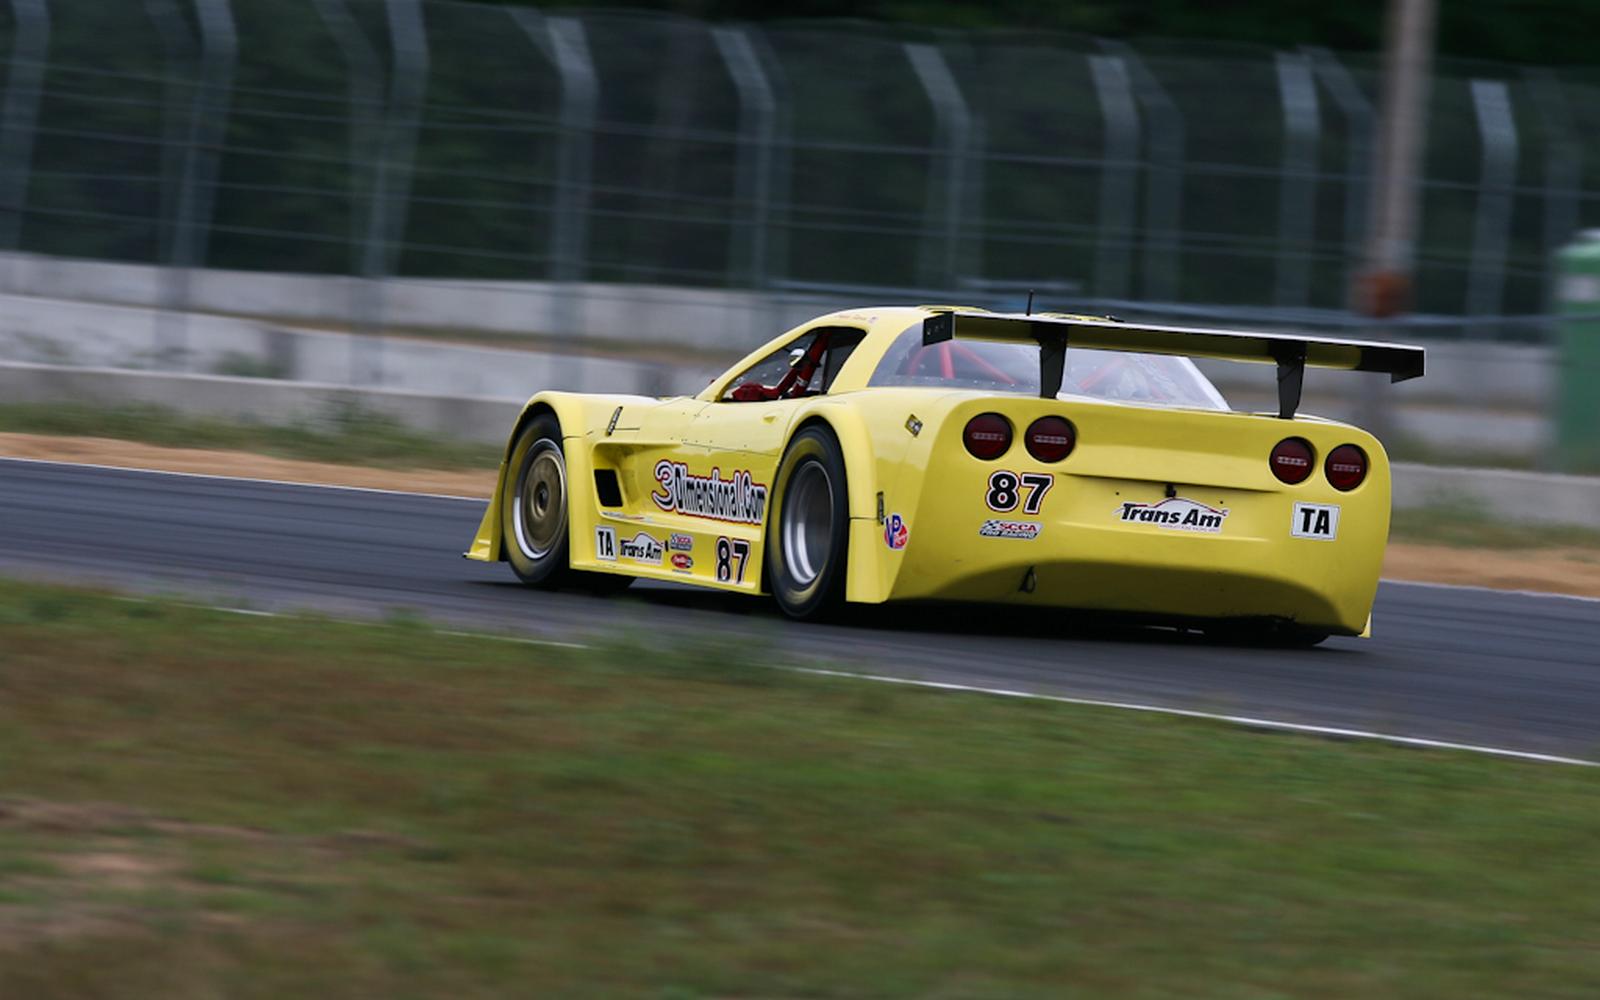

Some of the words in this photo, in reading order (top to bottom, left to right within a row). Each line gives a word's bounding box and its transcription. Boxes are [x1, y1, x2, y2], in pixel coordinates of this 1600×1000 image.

[985, 469, 1054, 515] 87
[999, 522, 1037, 532] SCCA
[1121, 503, 1181, 523] Trans
[1182, 508, 1222, 527] Am
[1300, 507, 1331, 535] TA
[598, 530, 614, 556] TA
[620, 539, 645, 558] Trans
[645, 541, 662, 560] Am
[716, 536, 751, 584] 87
